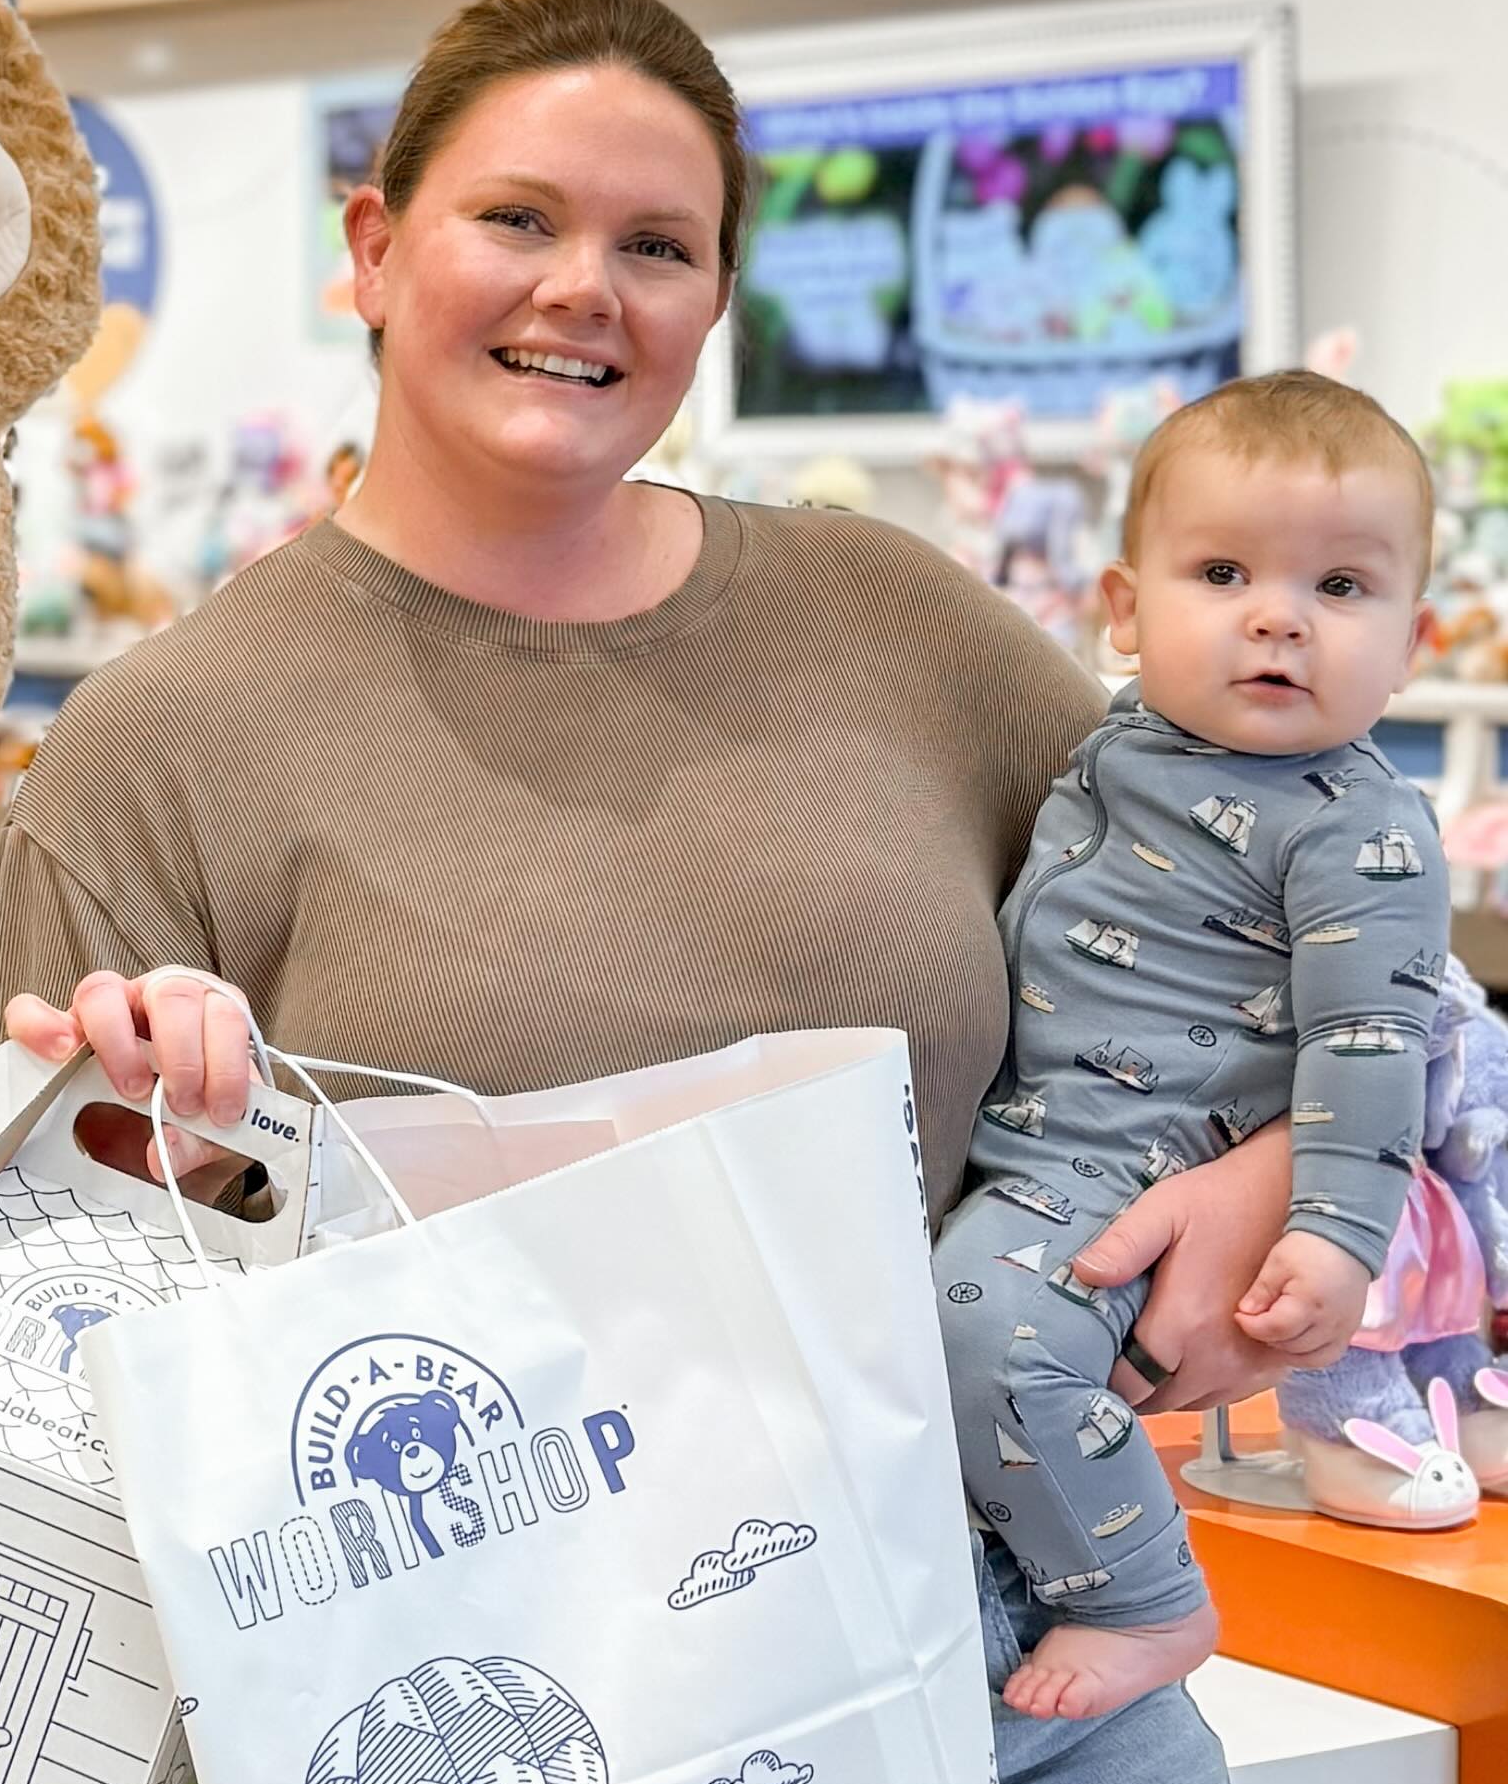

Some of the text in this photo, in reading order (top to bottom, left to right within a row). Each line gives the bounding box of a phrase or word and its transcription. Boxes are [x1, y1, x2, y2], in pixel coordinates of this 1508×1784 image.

[251, 1108, 300, 1143] love.
[306, 1354, 504, 1492] BUILD-A-BEAR
[208, 1409, 636, 1630] WORKSHOP
